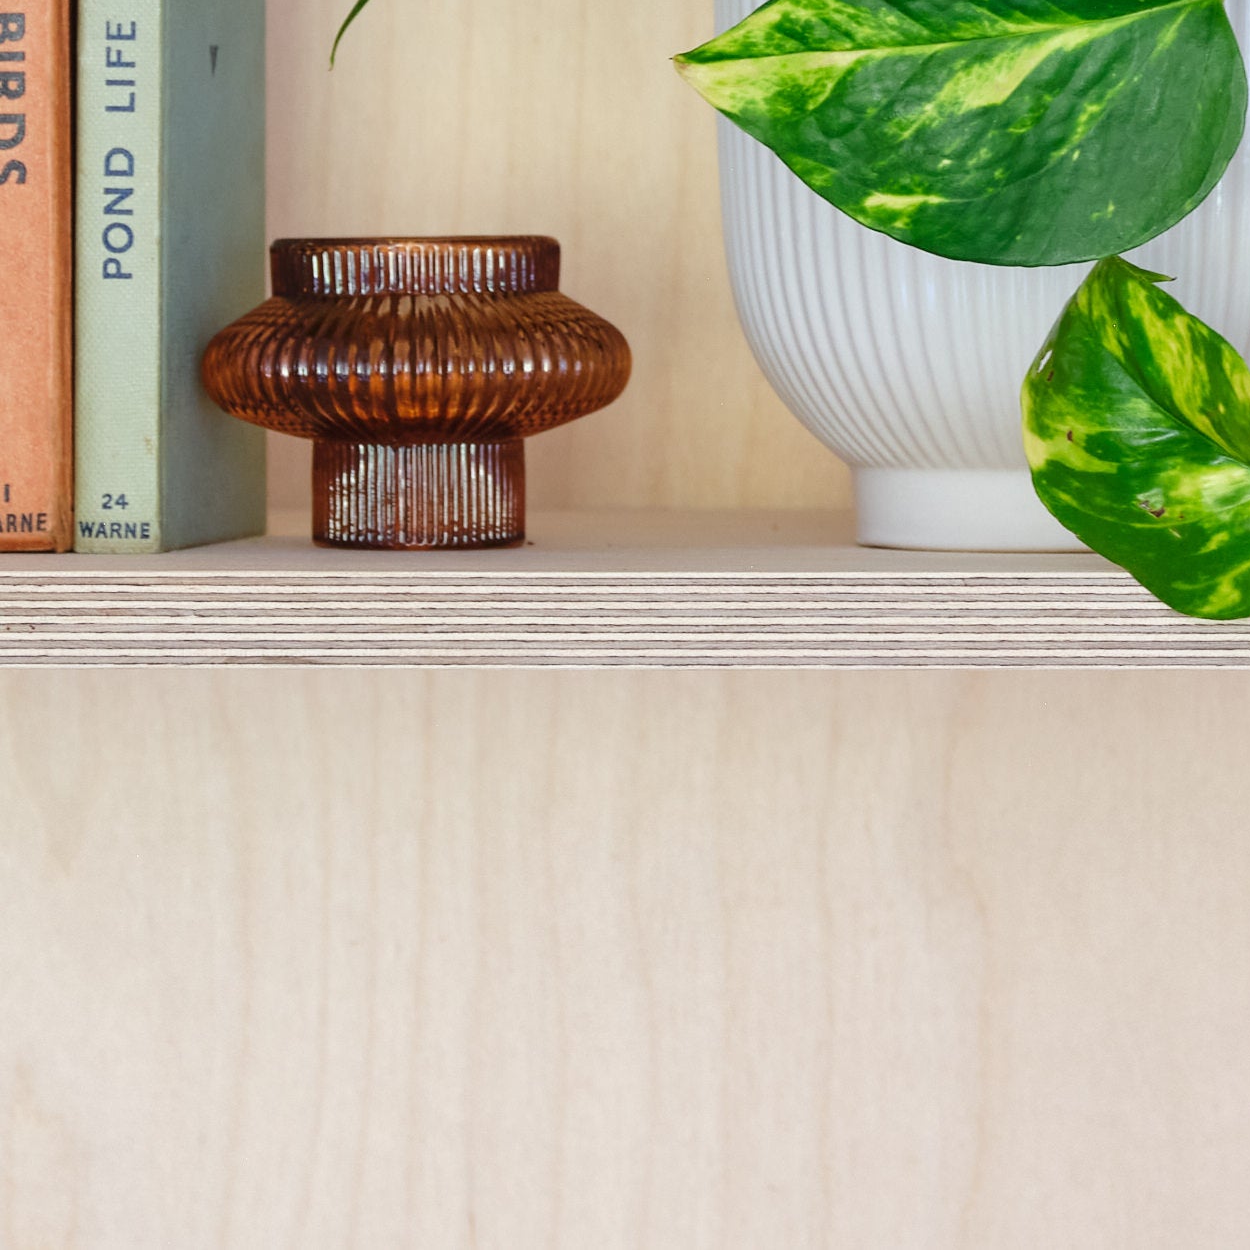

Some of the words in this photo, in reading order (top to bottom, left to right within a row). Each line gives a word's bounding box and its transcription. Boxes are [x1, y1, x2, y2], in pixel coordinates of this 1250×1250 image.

[0, 13, 27, 185] BIRDS
[105, 21, 136, 113] LIFE
[102, 147, 135, 279] POND
[79, 521, 151, 539] WARNE
[101, 493, 129, 510] 24
